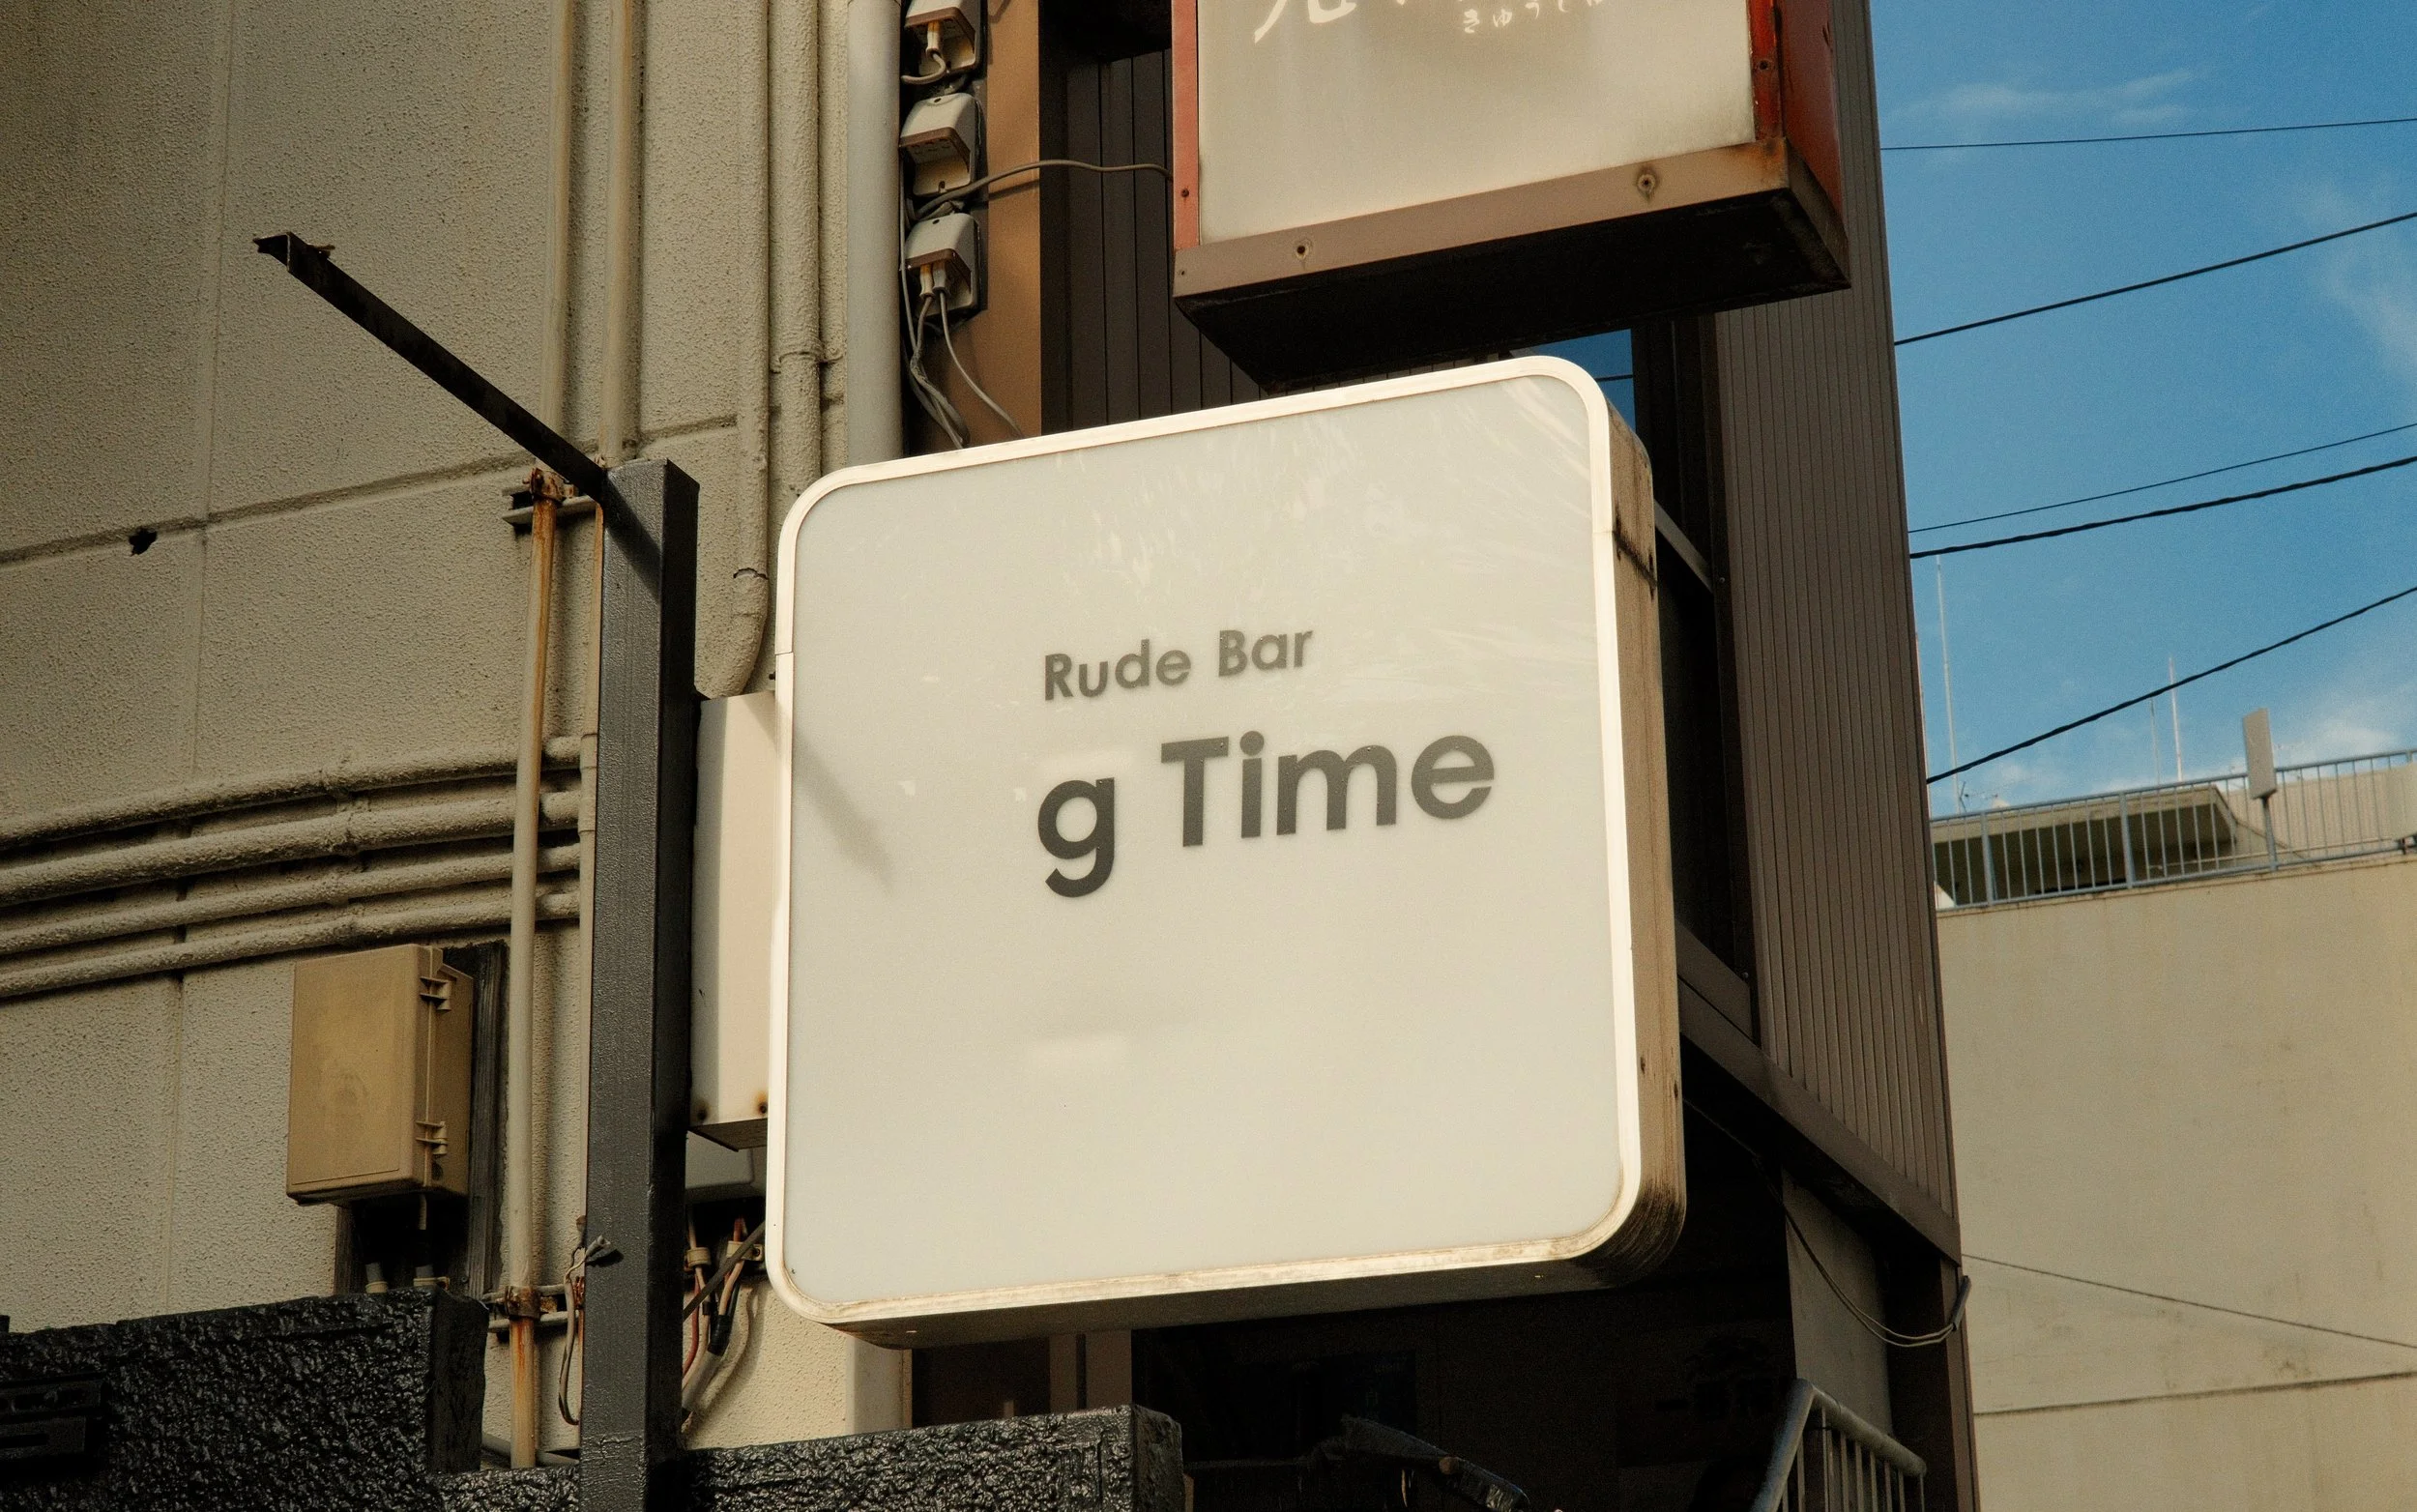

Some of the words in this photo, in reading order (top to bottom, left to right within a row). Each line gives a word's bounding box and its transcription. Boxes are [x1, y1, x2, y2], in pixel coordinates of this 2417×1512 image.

[1045, 639, 1191, 700] Rude
[1218, 629, 1313, 677] Bar
[1037, 777, 1116, 898] g
[1161, 731, 1495, 847] Time
